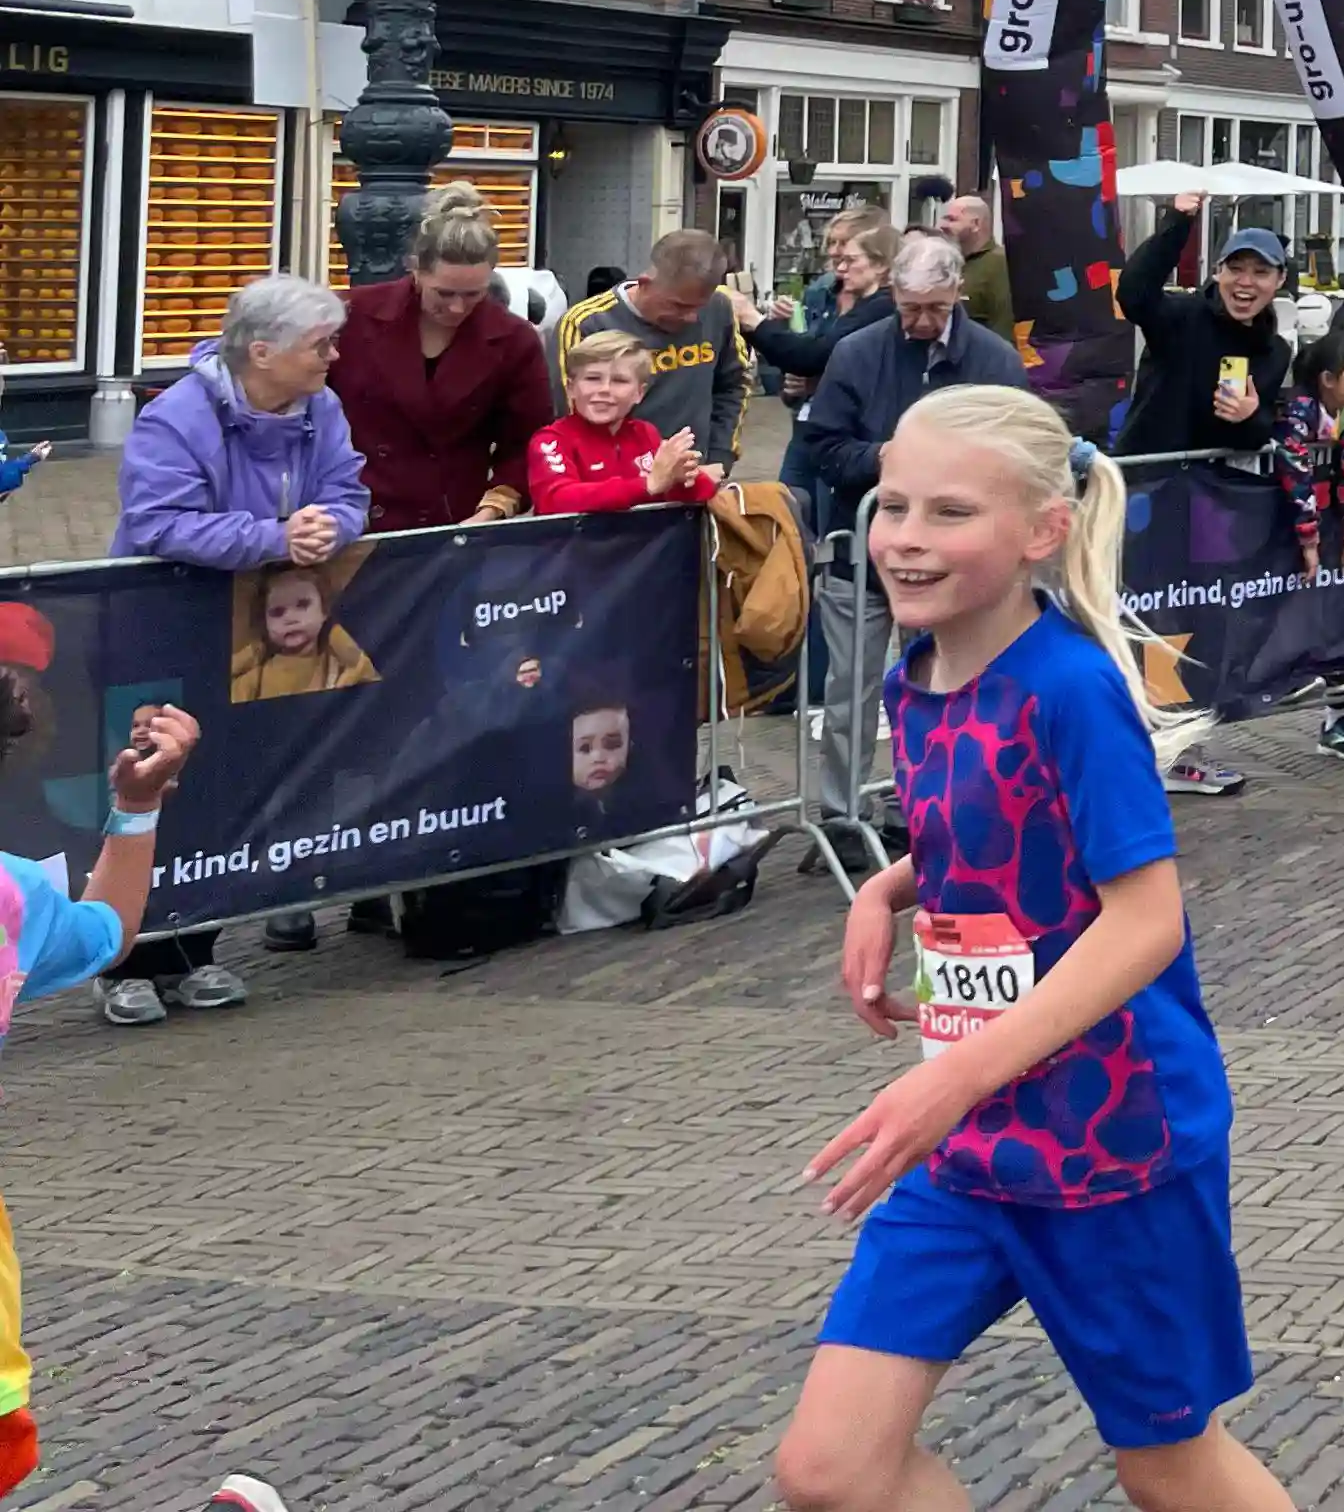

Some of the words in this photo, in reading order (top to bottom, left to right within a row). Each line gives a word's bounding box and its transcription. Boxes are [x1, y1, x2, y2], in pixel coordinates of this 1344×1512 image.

[0, 42, 69, 73] LIG
[428, 70, 466, 90] EESE
[469, 73, 531, 95] MAKERS
[533, 77, 577, 98] SINCE
[579, 82, 615, 100] 1974
[474, 589, 567, 628] gro-up
[1167, 580, 1227, 608] kind,
[1230, 571, 1284, 609] gezin
[173, 841, 259, 886] kind,
[266, 823, 362, 873] gezin
[369, 818, 411, 844] en
[417, 796, 508, 836] buurt
[937, 961, 1019, 1003] 1810
